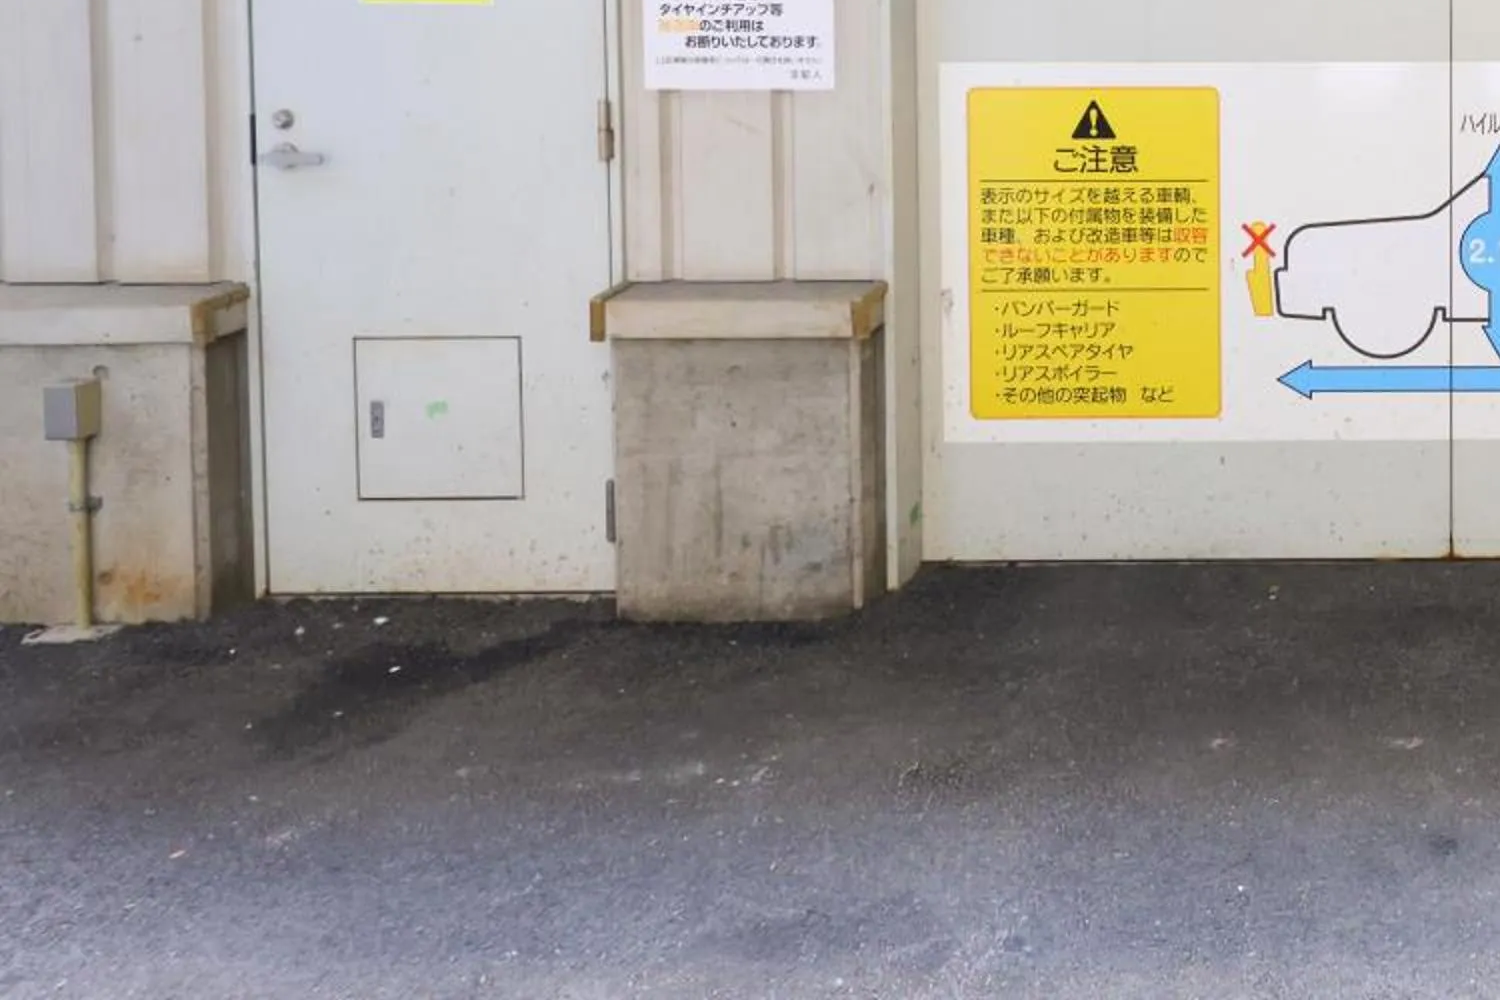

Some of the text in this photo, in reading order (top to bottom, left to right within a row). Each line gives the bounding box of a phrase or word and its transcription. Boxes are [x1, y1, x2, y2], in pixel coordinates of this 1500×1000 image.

[659, 19, 764, 33] のご利用は
[1053, 145, 1138, 174] ご注意
[980, 207, 1208, 225] また以下の付属物を装備した
[982, 247, 1208, 264] できないことがありますので
[980, 267, 1112, 285] ご了承願います。
[1141, 387, 1176, 403] など
